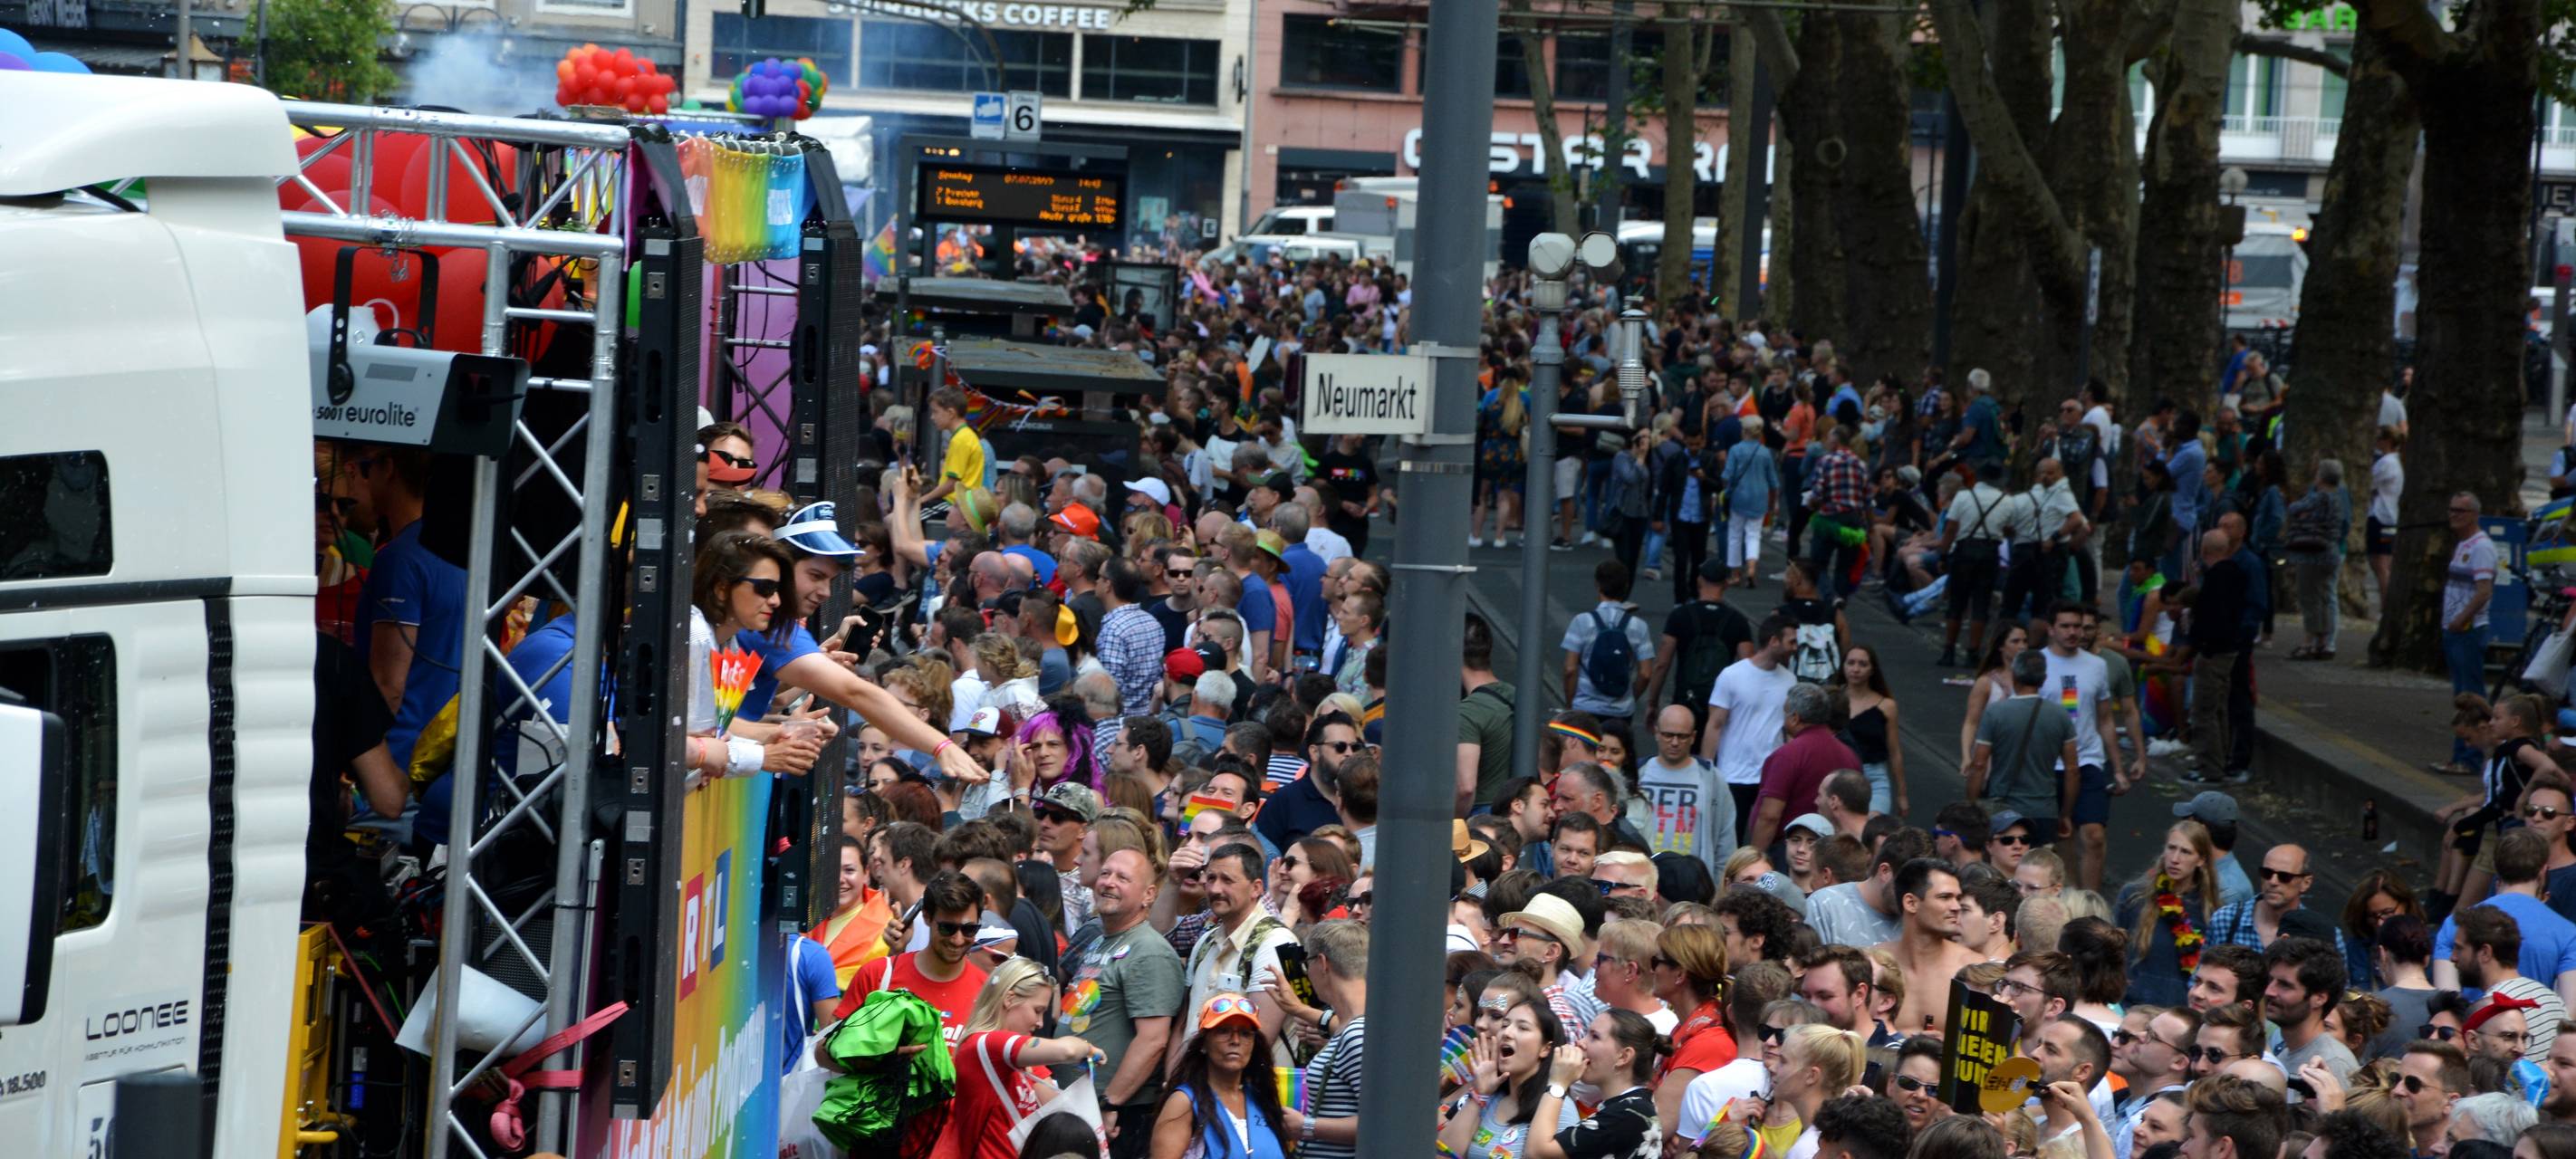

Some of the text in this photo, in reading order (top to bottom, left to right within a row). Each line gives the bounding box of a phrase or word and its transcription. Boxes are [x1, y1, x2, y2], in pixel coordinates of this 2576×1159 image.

[1003, 5, 1111, 29] COFFEE
[1015, 105, 1033, 131] 6
[1316, 373, 1417, 419] Neumarkt
[346, 401, 416, 427] eurolite
[682, 871, 726, 981] RTL
[86, 1000, 189, 1040] LOONEE
[6, 1070, 46, 1096] 18.500
